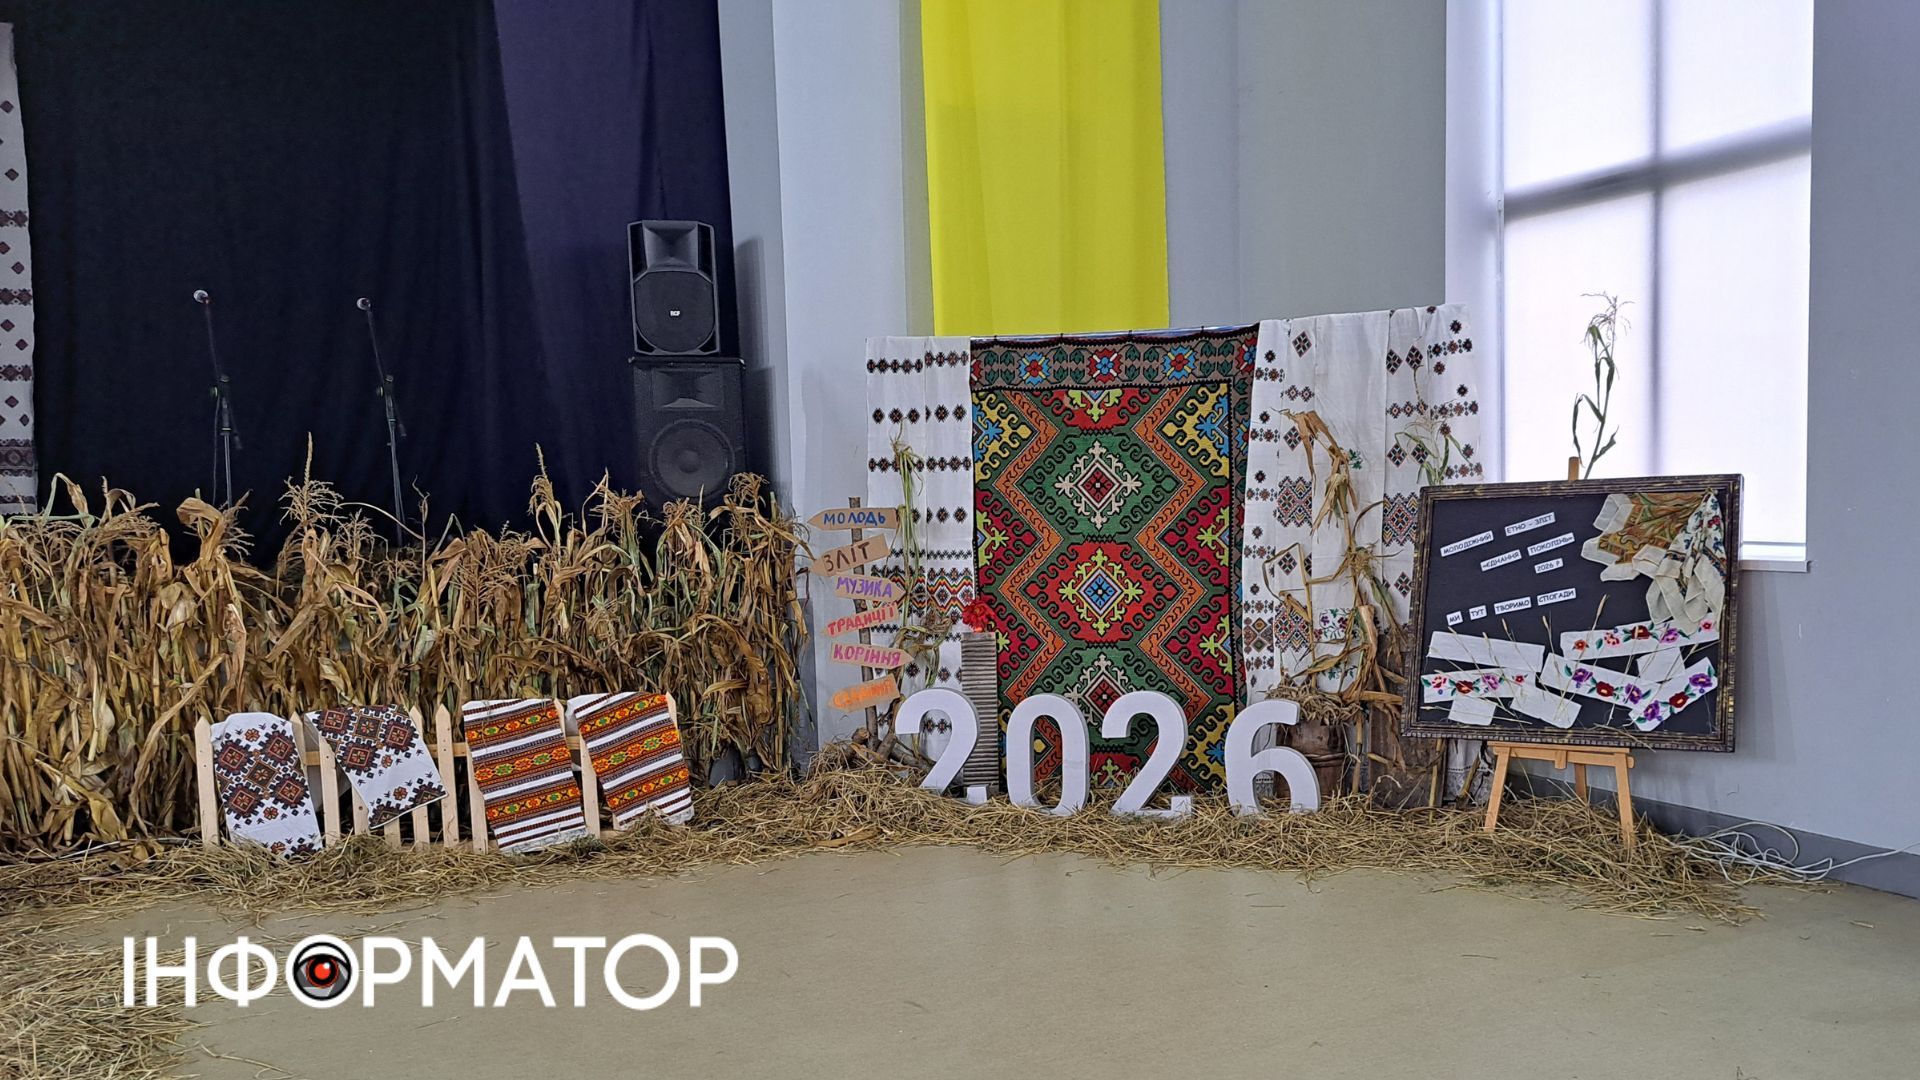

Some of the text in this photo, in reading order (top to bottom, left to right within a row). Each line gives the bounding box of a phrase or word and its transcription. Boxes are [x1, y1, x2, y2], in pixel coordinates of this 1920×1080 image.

[823, 511, 886, 526] МОЛОДЬ
[1443, 532, 1492, 554] МОЛОДІЖНИЙ
[1506, 523, 1526, 534] ЕТНО
[1534, 514, 1553, 525] ЗЛІТ
[823, 541, 870, 572] ЗЛІТ
[1537, 563, 1554, 572] 2026
[836, 576, 892, 598] МУЗИКА
[827, 602, 896, 635] ТРАДИЦІЇ
[1449, 590, 1575, 624] МИ ТУТ ТВОРИМО СПОГАДИ
[833, 643, 901, 667] КОРІННЯ
[895, 687, 1320, 817] 2026
